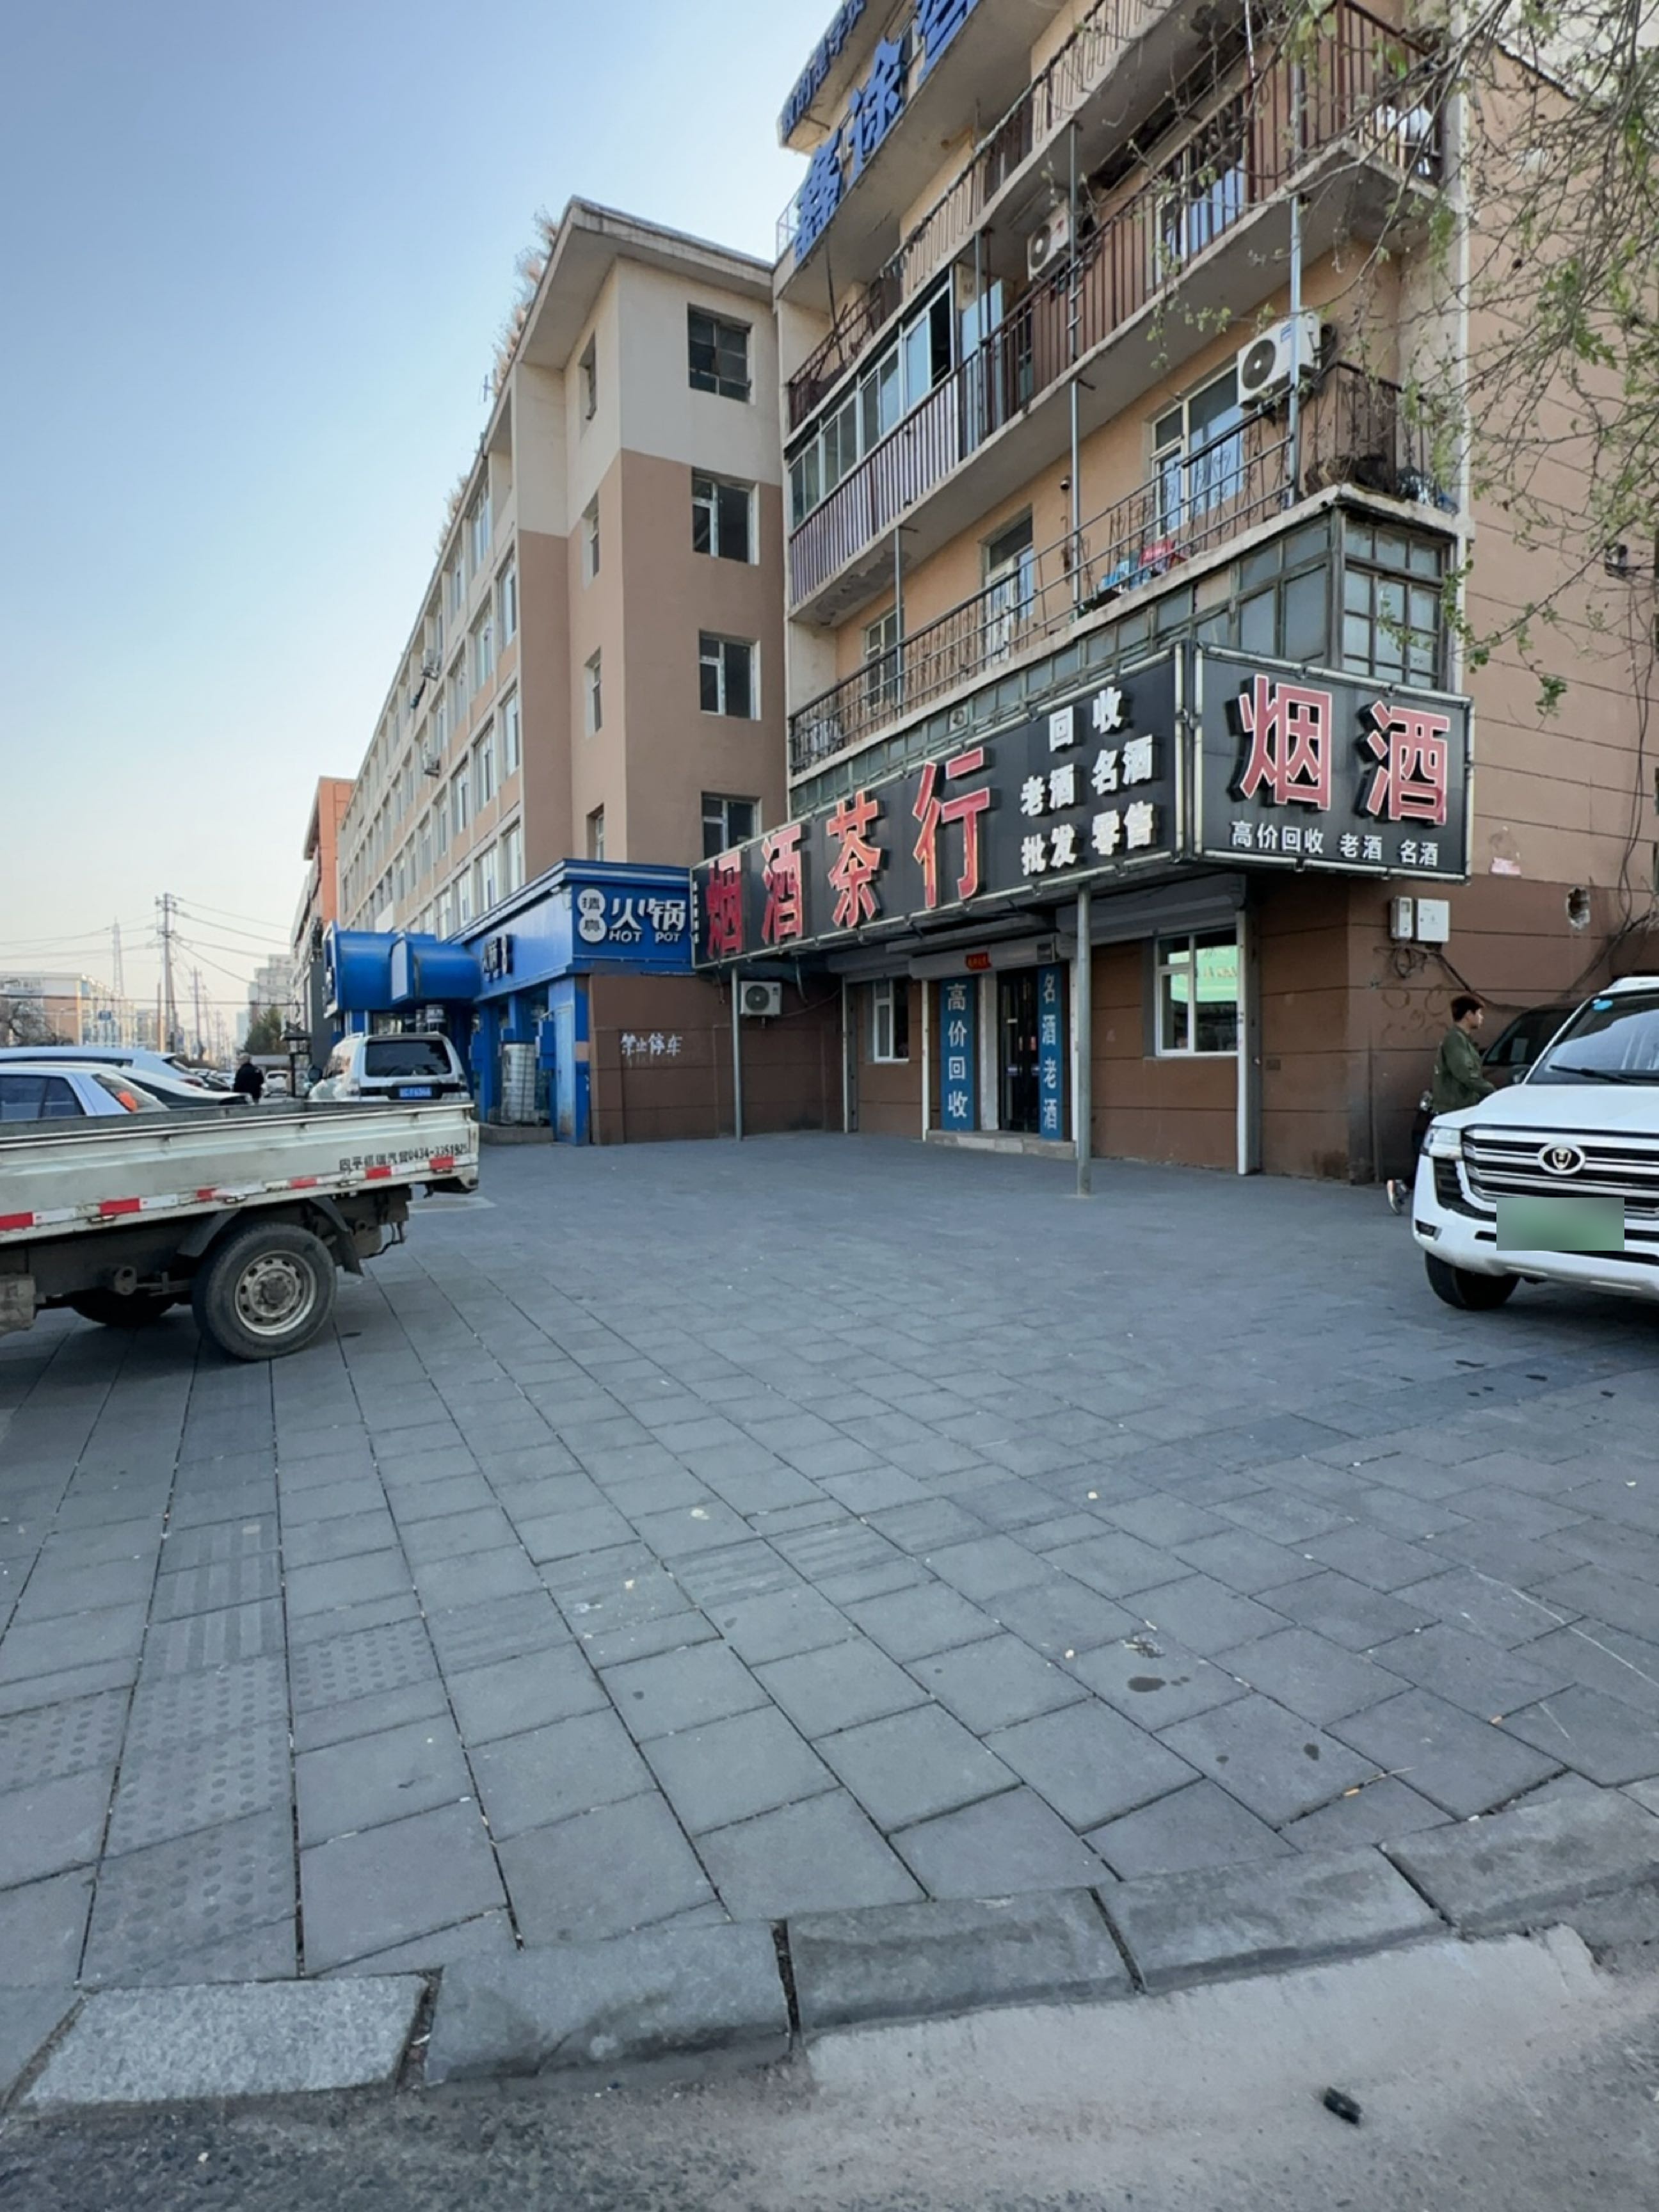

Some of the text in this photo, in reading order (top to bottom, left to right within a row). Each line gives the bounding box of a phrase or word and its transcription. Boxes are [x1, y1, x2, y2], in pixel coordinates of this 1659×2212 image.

[1048, 686, 1123, 752] 回收
[1238, 673, 1450, 826] 烟酒
[1020, 733, 1153, 817] 老酒 名酒
[707, 746, 991, 959] 烟酒茶行
[1021, 800, 1153, 876] 批发 零售
[1230, 819, 1439, 867] 高价回收 老酒 名酒
[608, 897, 687, 932] 火锅
[609, 931, 682, 944] HOT POT
[620, 1032, 683, 1057] 禁止停车
[946, 982, 968, 1119] 高价回收
[1041, 972, 1059, 1130] 名酒老酒
